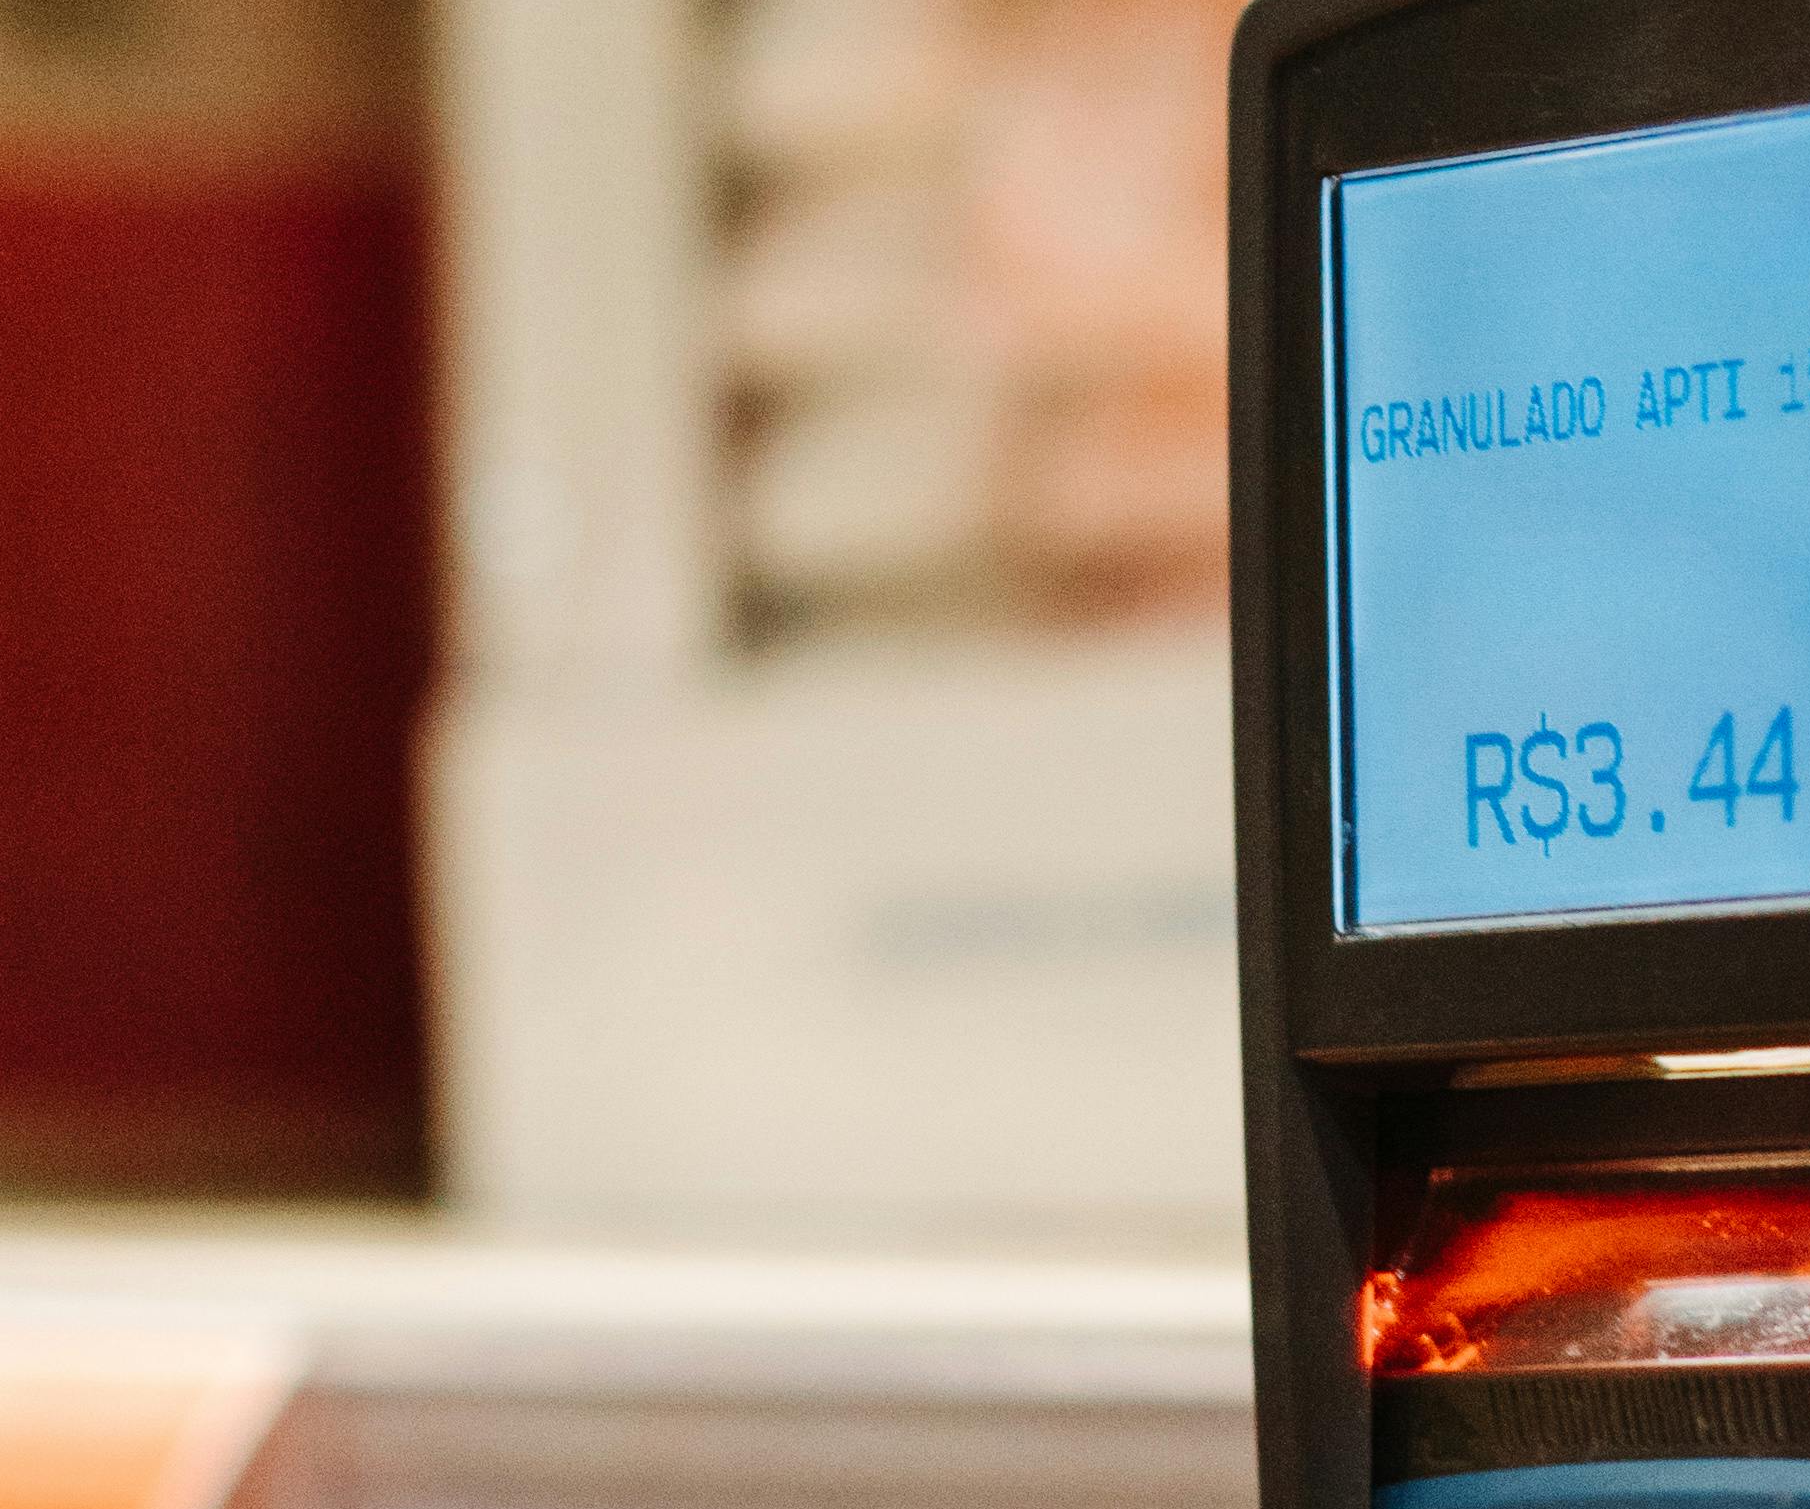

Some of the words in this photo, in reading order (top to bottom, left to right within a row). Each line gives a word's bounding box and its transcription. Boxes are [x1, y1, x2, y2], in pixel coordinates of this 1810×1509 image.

[1361, 376, 1606, 464] GRANULADO
[1635, 358, 1747, 431] APTI
[1465, 704, 1800, 857] R$3.44
